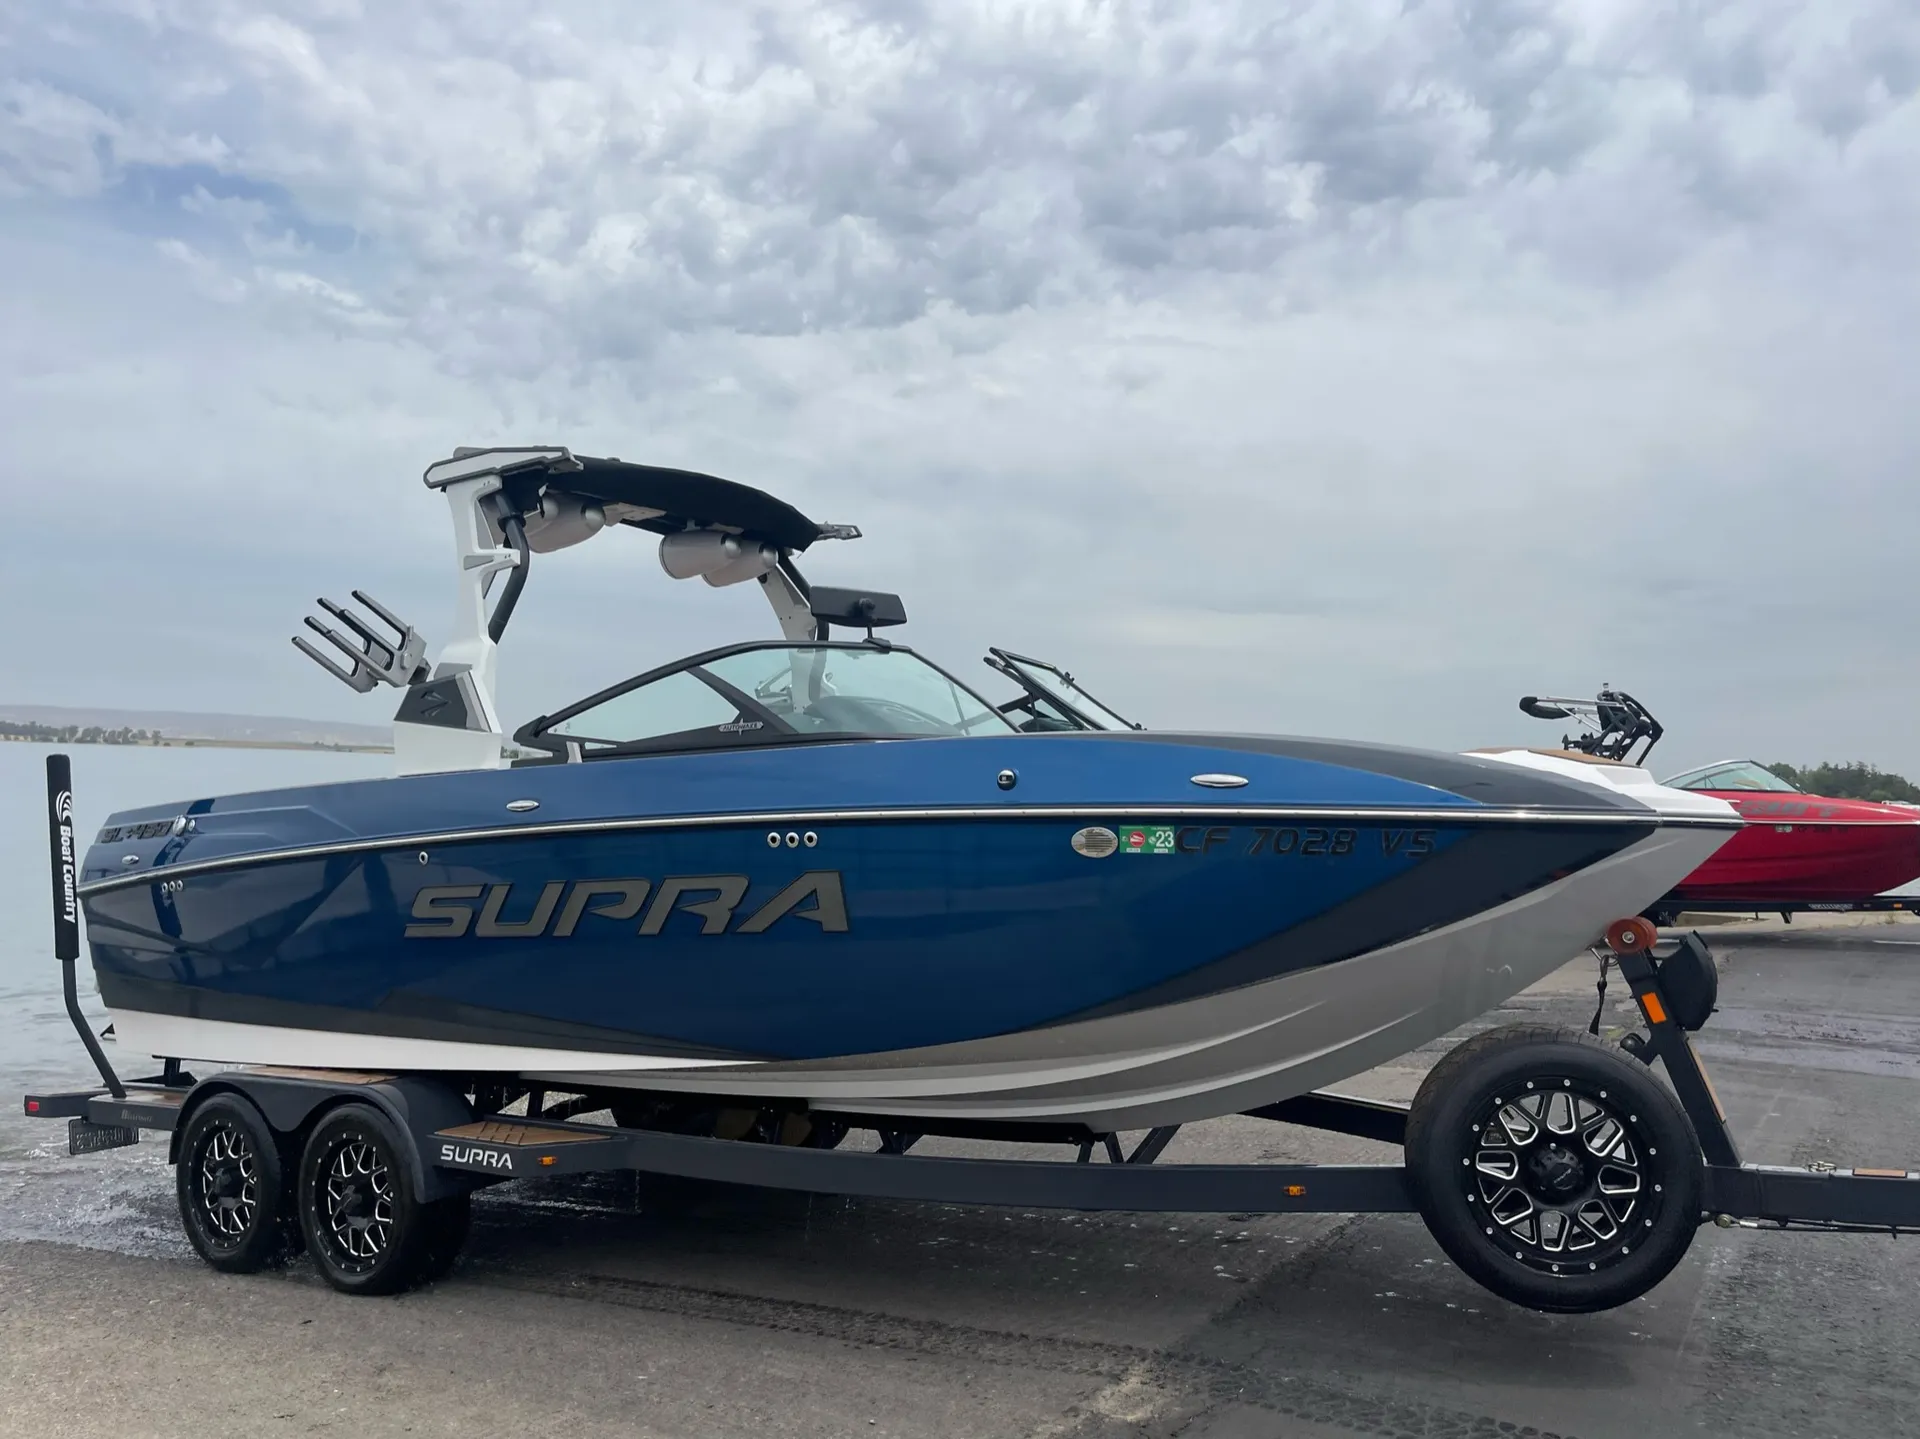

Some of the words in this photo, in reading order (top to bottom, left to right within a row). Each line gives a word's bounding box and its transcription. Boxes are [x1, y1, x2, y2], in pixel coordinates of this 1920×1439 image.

[60, 825, 73, 862] Boat
[1156, 831, 1174, 847] 23
[1175, 826, 1233, 854] CF
[1248, 827, 1358, 856] 7028
[63, 864, 76, 923] Country
[403, 870, 849, 938] SUPRA
[440, 1144, 513, 1170] SUPRA
